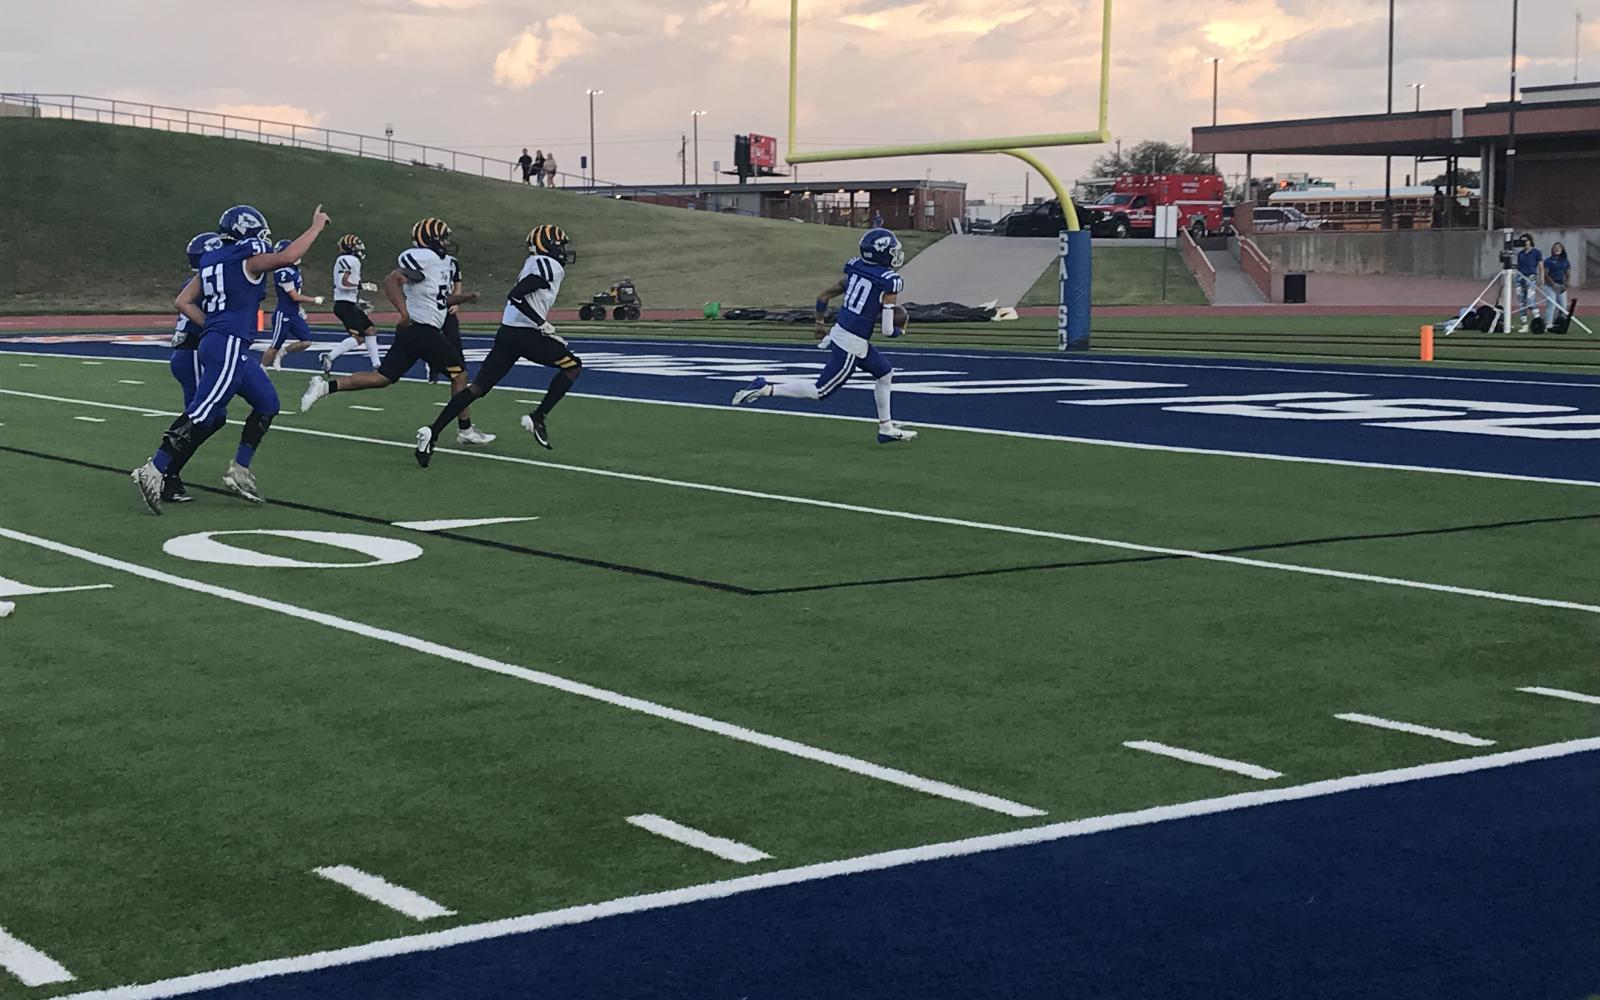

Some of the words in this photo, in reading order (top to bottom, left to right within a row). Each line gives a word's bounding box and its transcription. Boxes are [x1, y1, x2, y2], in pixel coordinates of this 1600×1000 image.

[201, 262, 227, 313] 51
[280, 271, 288, 282] 2
[892, 278, 904, 294] 10
[842, 273, 873, 316] 10
